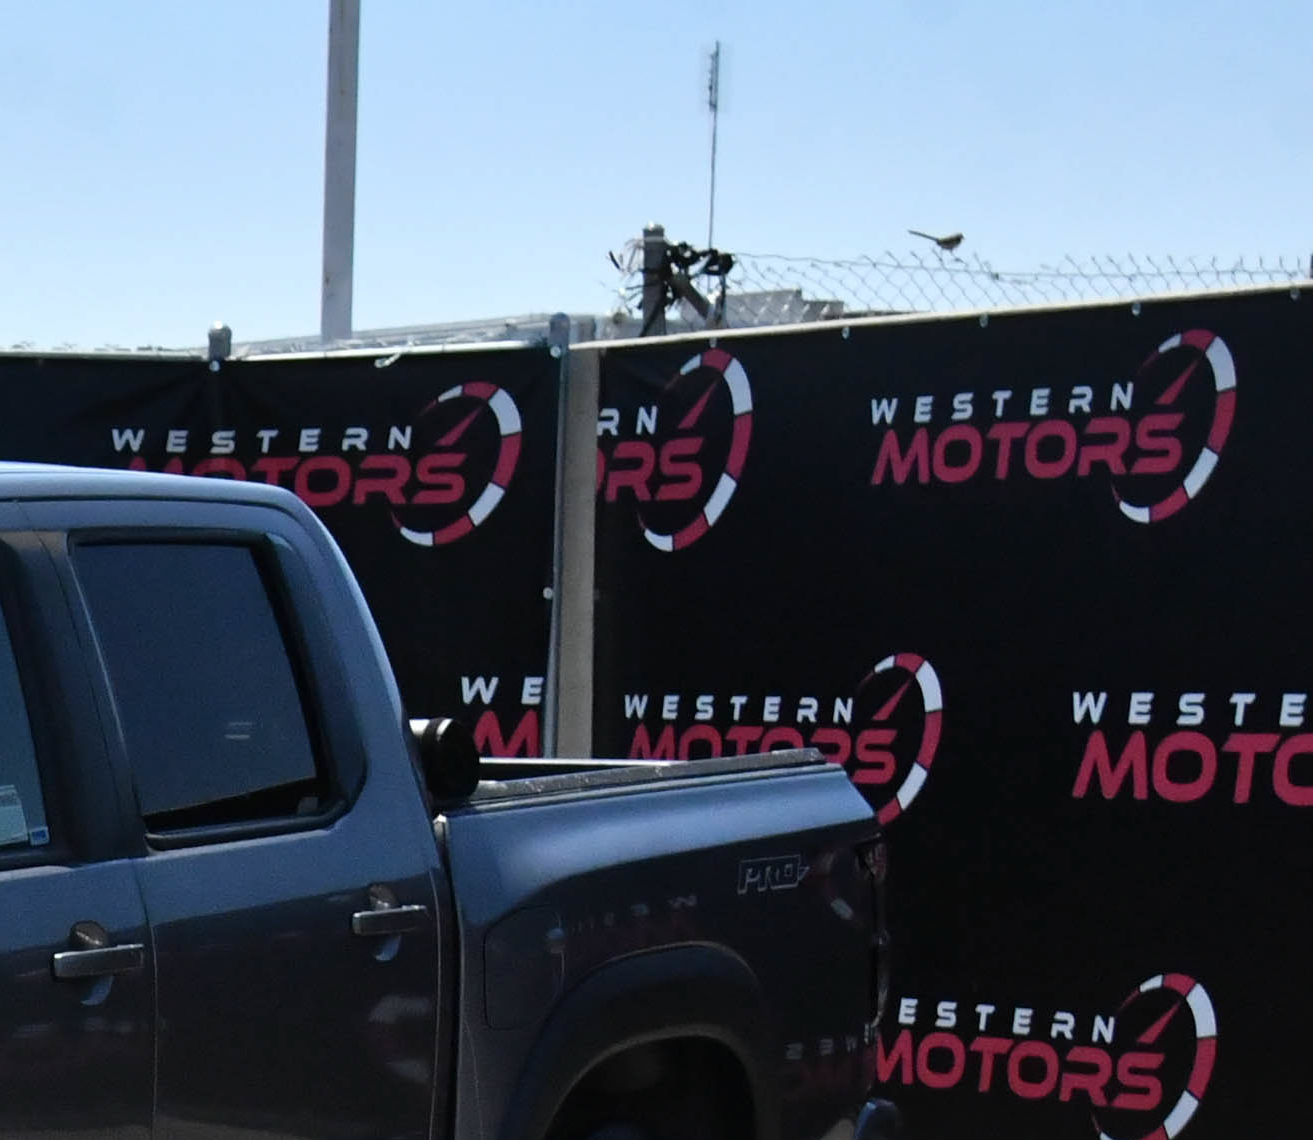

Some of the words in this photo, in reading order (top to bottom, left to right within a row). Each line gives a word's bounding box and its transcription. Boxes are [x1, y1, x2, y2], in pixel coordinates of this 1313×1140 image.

[871, 382, 1135, 425] WESTERN
[112, 425, 413, 454] WESTERN
[870, 413, 1185, 485] MOTORS
[129, 454, 467, 508] TORS
[597, 436, 704, 502] RS
[461, 676, 544, 705] WE
[624, 694, 853, 724] WESTERN
[1072, 692, 1308, 727] WESTE
[898, 997, 1115, 1044] ESTERN
[876, 1029, 1166, 1111] MOTORS
